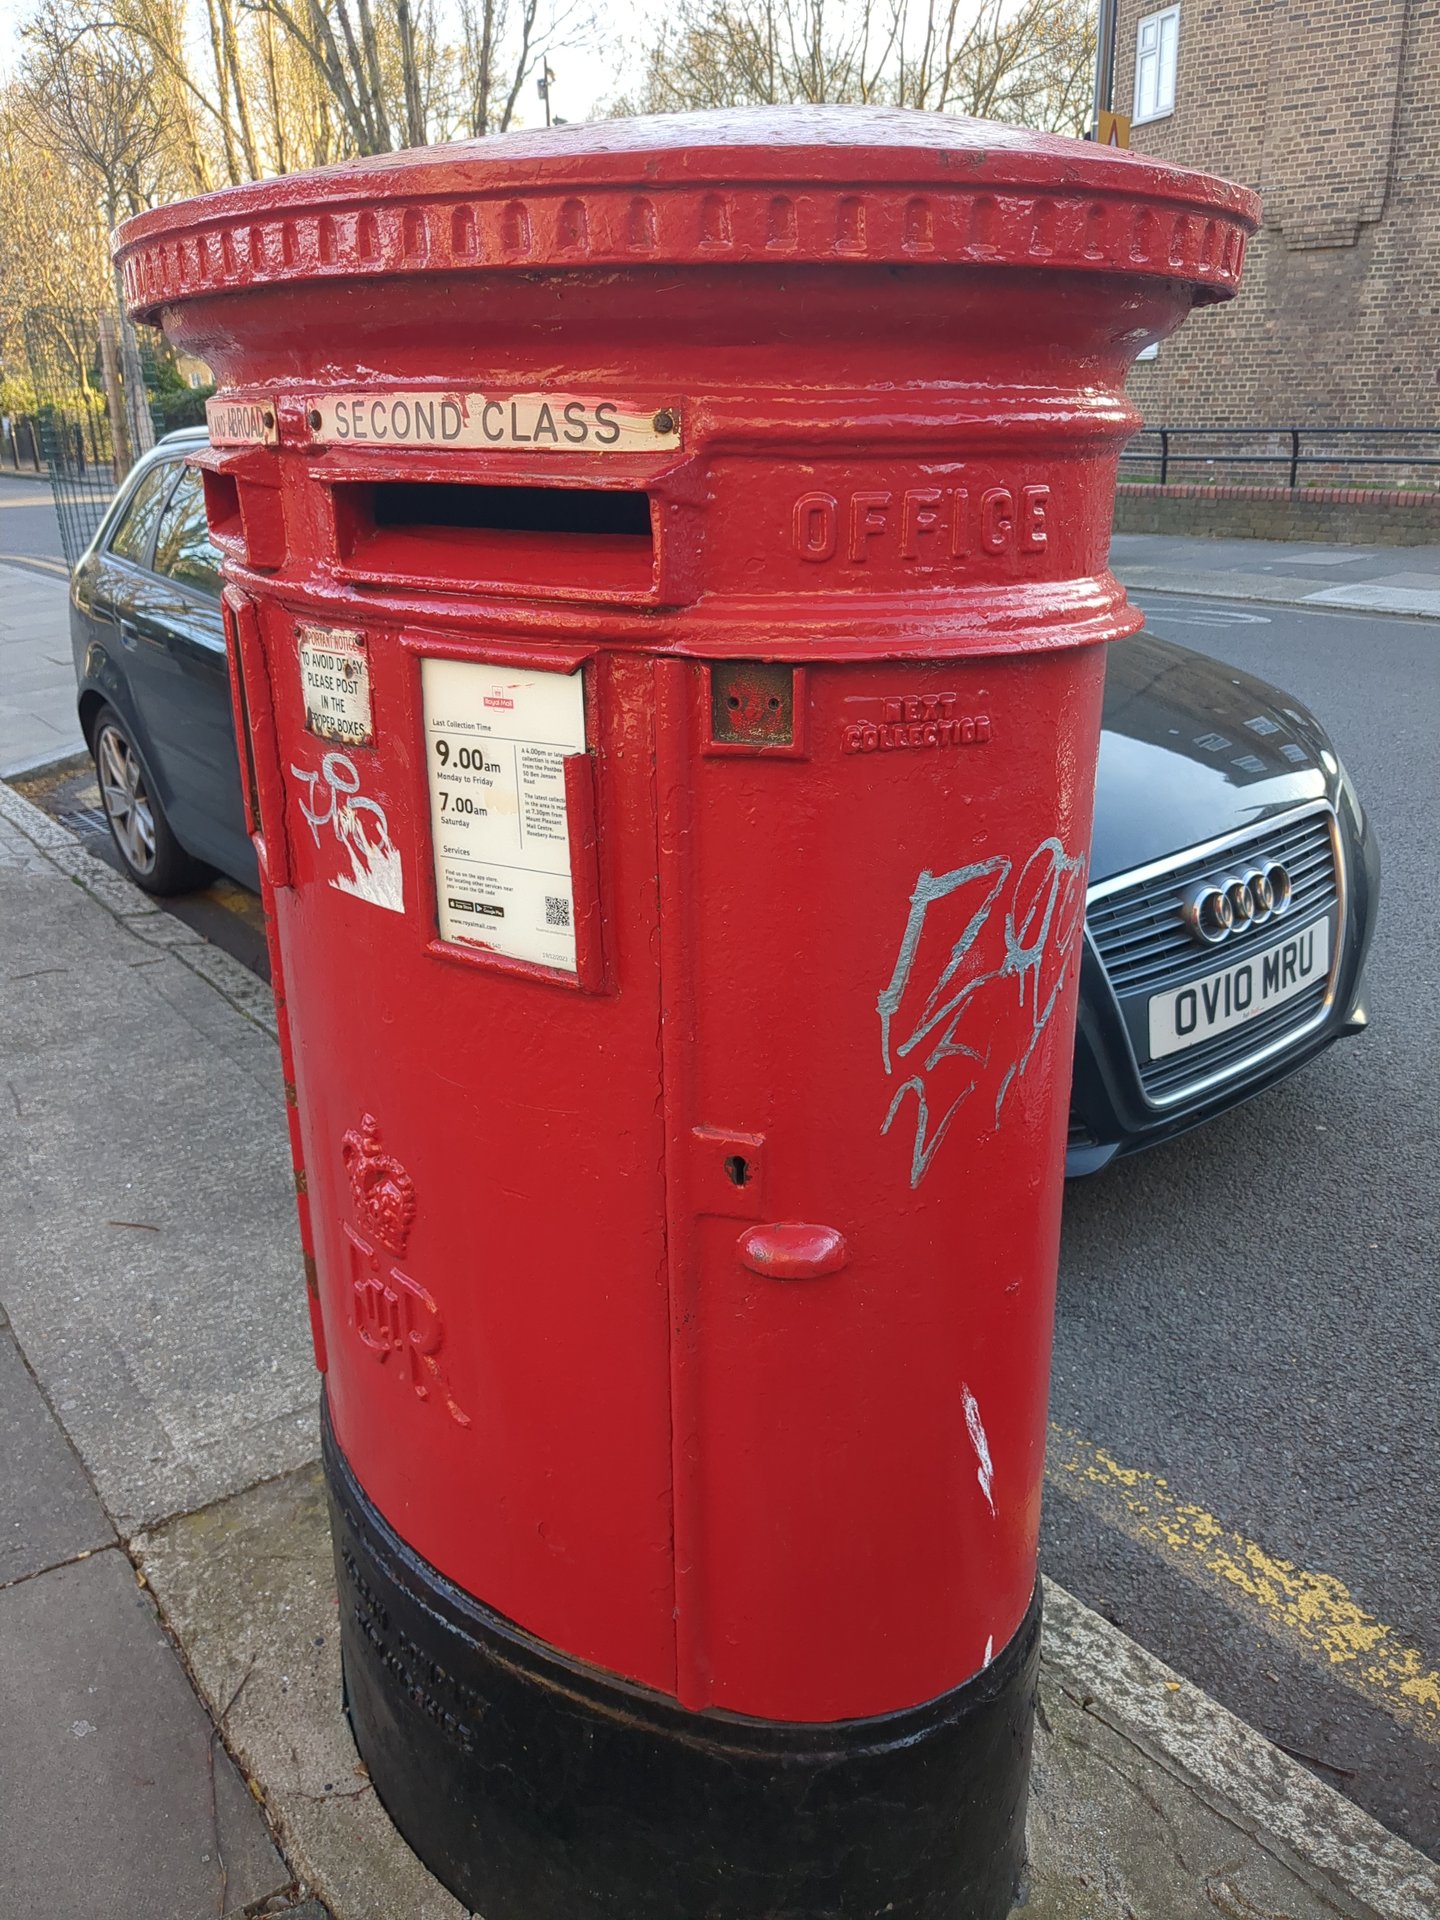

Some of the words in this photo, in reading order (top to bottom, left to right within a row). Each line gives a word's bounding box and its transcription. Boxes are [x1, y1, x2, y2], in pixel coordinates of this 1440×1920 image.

[227, 406, 265, 438] ABROAD
[335, 400, 462, 440] SECOND
[482, 402, 621, 444] CLASS
[792, 485, 1050, 563] OFFICE
[301, 651, 311, 666] TO
[312, 655, 334, 671] AVOID
[308, 672, 334, 691] PLEASE
[336, 678, 359, 695] POST
[321, 694, 329, 709] IN
[331, 697, 346, 713] THE
[882, 692, 956, 723] NEXT
[337, 718, 365, 736] BOXES
[432, 718, 446, 727] Last
[446, 720, 475, 730] Collection
[476, 723, 492, 731] Time
[841, 715, 993, 755] COLLECTION
[435, 739, 501, 773] 9.00am
[437, 771, 462, 783] Monday
[473, 776, 493, 787] Friday
[438, 791, 488, 816] 7.00am
[441, 816, 470, 828] Saturday
[443, 845, 471, 856] Services
[450, 919, 498, 930] www.royalmail.com
[1174, 964, 1252, 1036] OV10
[1262, 930, 1314, 1000] MRU
